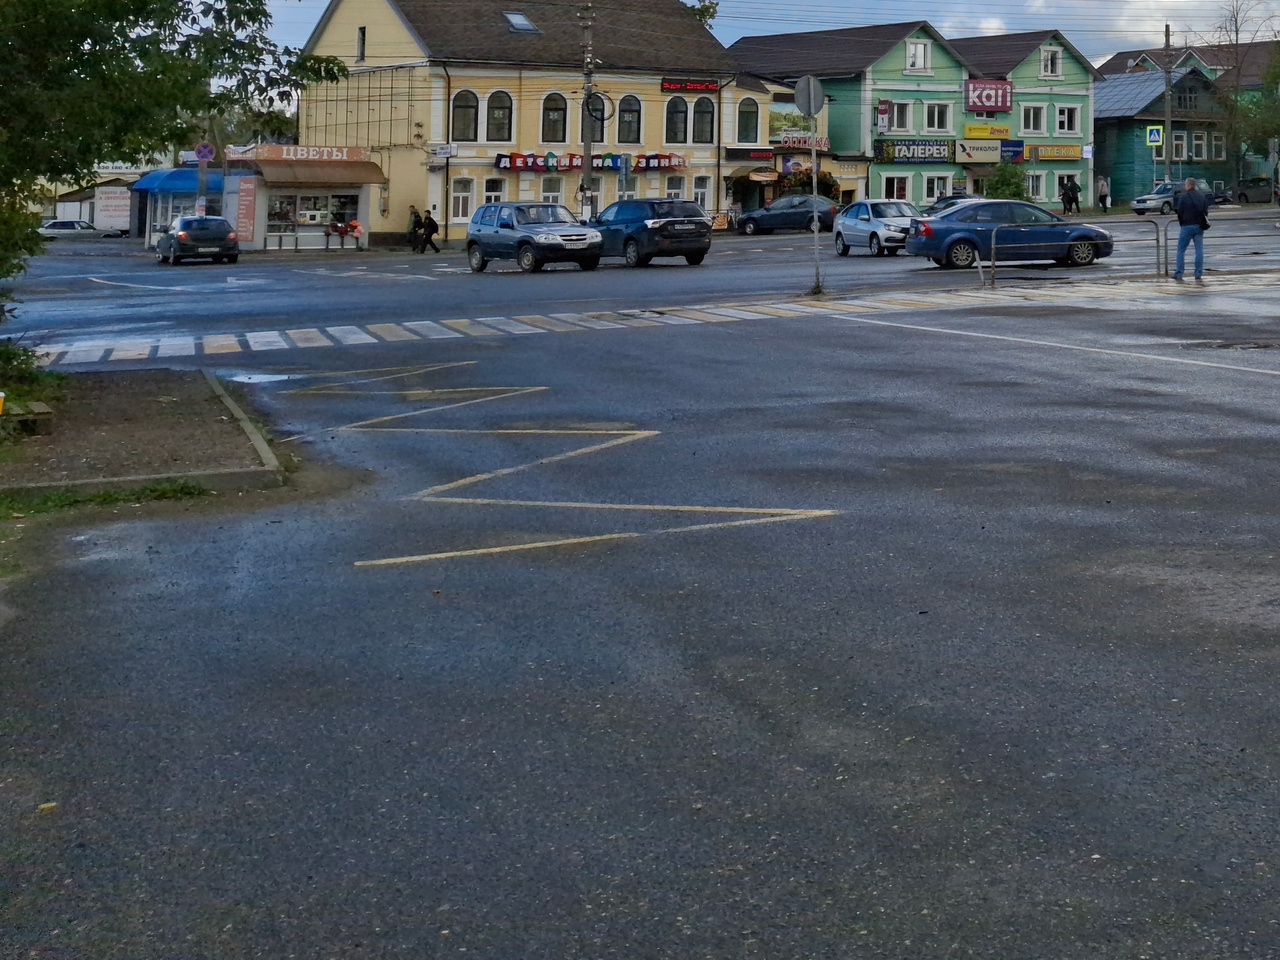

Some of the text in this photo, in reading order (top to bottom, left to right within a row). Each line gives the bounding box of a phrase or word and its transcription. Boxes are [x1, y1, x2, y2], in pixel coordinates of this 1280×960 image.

[969, 83, 1011, 106] kari
[281, 146, 348, 160] ЦВЕТЫ
[894, 145, 948, 157] ГАЛЕРЕЯ
[1037, 147, 1075, 156] ПТЕКА
[500, 155, 581, 168] ДЕТСКИЙ
[593, 158, 668, 167] МАЗИН
